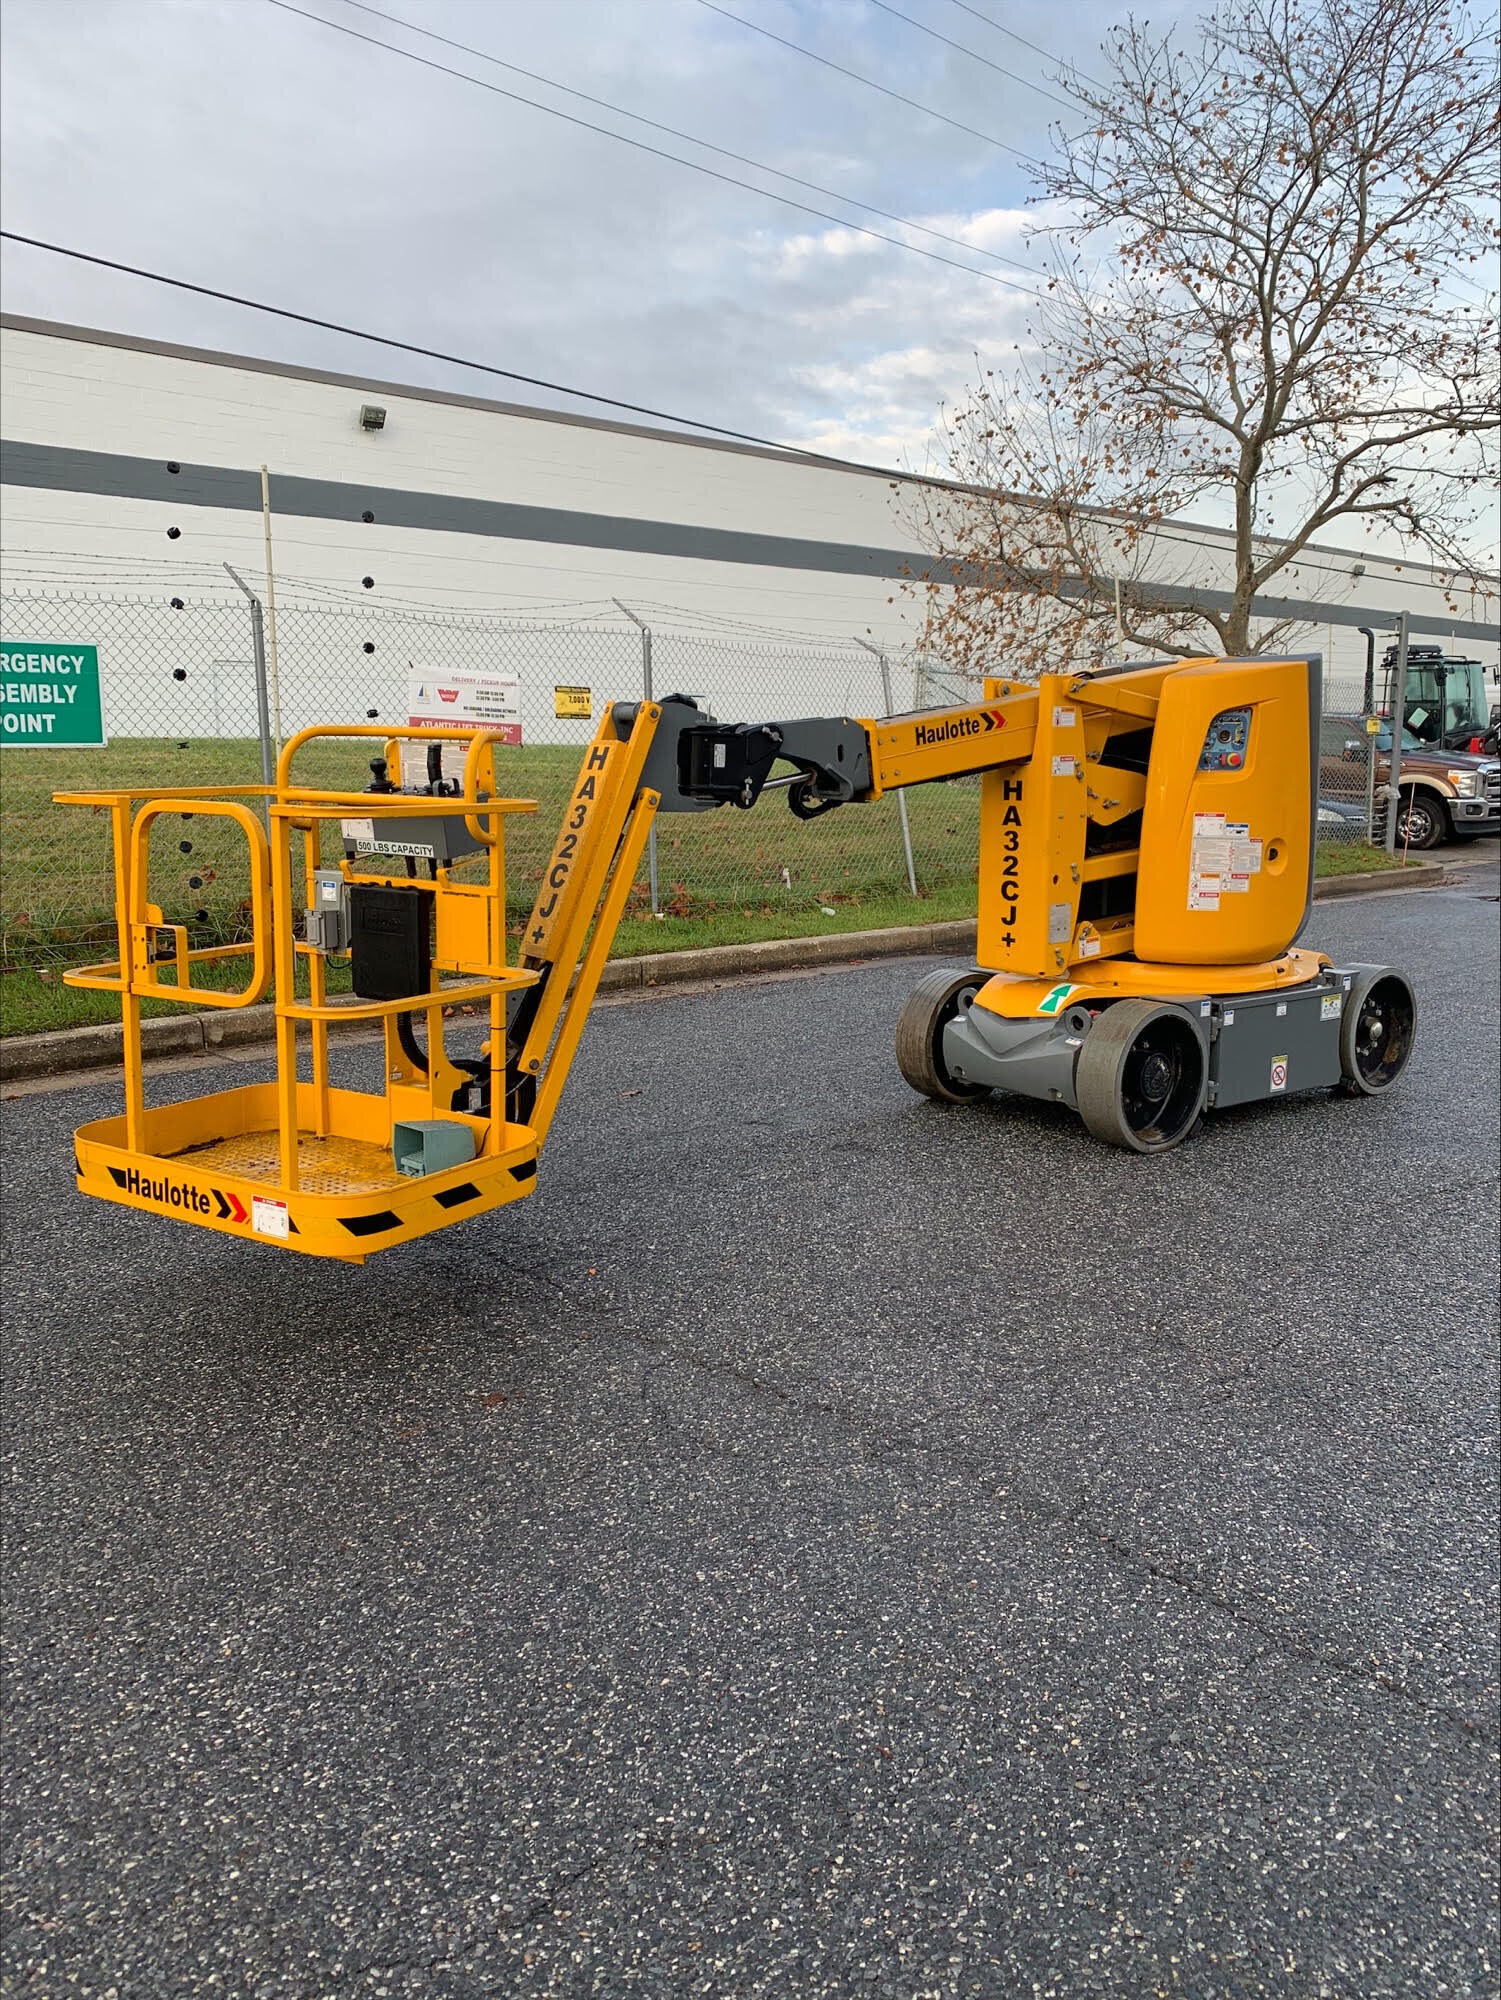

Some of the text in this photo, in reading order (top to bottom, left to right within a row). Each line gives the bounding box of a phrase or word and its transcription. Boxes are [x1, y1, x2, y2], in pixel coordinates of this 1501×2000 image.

[0, 713, 55, 733] OINT
[915, 716, 980, 746] Haulotte
[358, 841, 433, 856] 500 LBS CAPACITY
[127, 1167, 211, 1215] Haulotte
